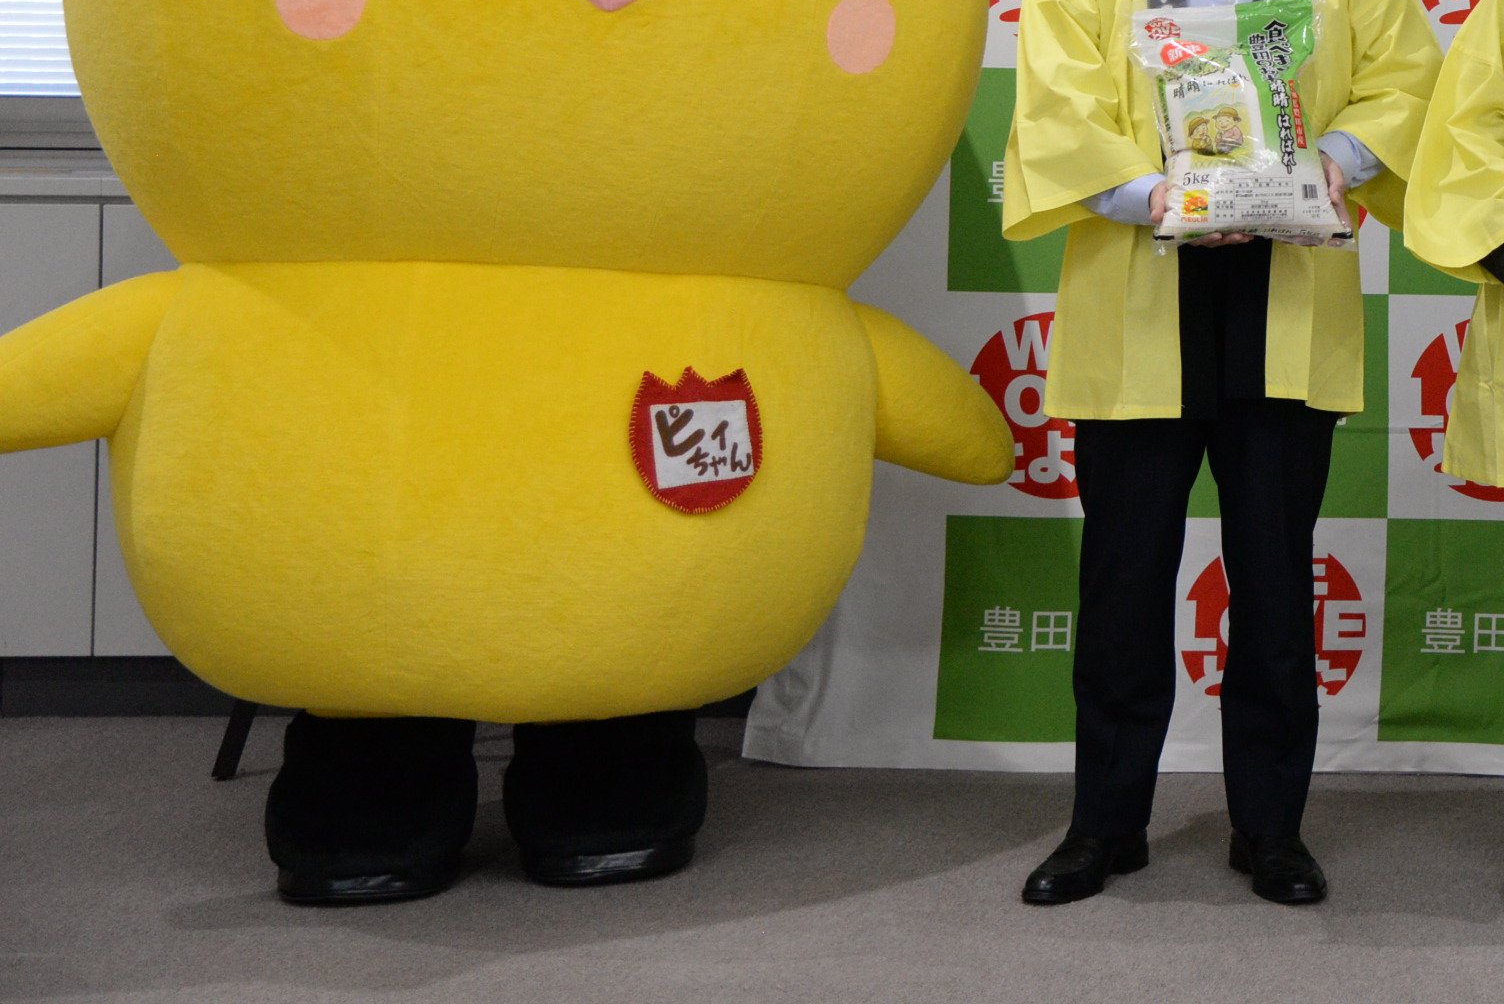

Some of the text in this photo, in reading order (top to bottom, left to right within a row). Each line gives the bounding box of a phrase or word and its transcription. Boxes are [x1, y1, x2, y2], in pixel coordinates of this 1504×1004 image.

[1183, 171, 1211, 186] 5kg
[687, 442, 751, 476] ちゃん
[978, 606, 1073, 653] 豊田
